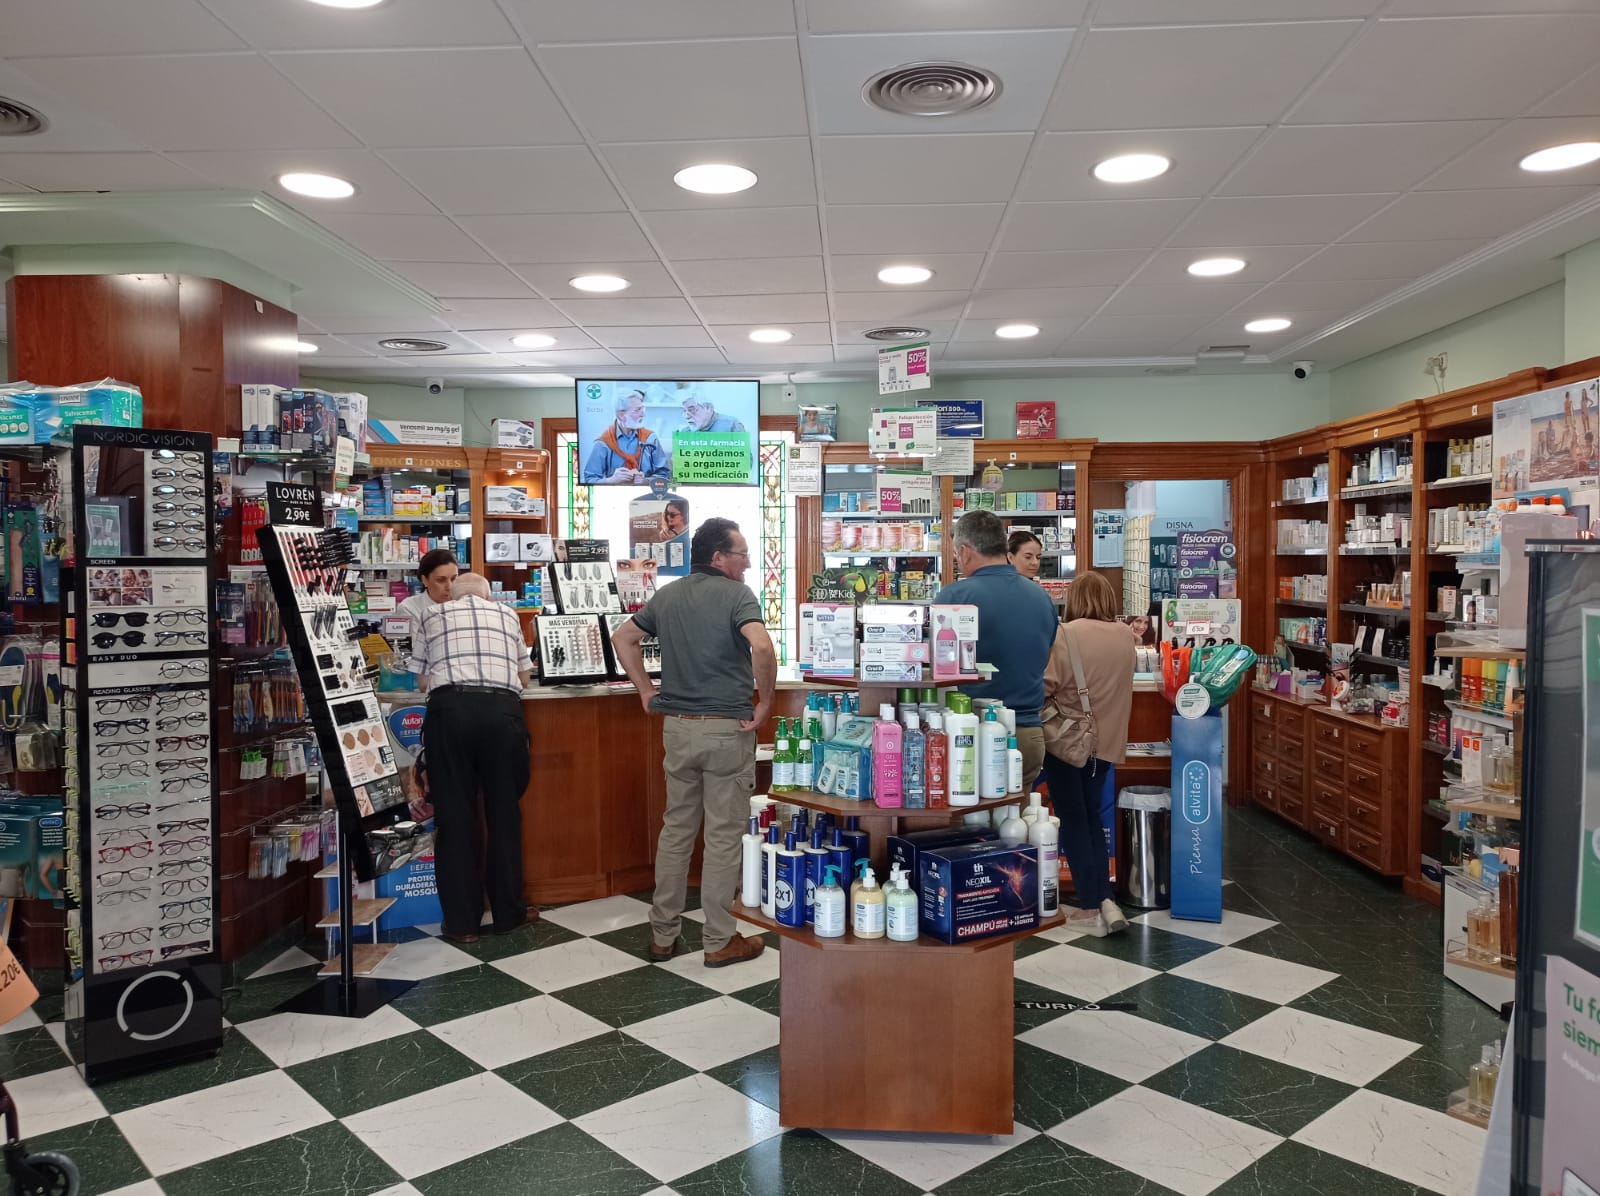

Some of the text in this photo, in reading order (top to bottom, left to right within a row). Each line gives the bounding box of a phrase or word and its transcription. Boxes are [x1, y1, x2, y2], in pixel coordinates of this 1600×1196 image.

[93, 431, 196, 447] NORDIC VISION
[709, 439, 746, 447] farmacia
[679, 449, 745, 460] Le ayudamos
[692, 461, 741, 470] organizar
[693, 471, 749, 479] medicación
[275, 486, 316, 501] LOVRÉN
[881, 490, 901, 501] 50%
[285, 507, 311, 522] 2,99€
[1166, 521, 1194, 529] DISNA
[1182, 533, 1229, 544] fisiocrem
[1180, 548, 1209, 556] fisiocrem
[838, 589, 856, 599] Kids
[120, 653, 138, 661] DUO
[1192, 781, 1201, 816] alvita
[1190, 827, 1203, 875] Piensa
[973, 863, 984, 873] th
[965, 876, 992, 887] NEOXIL
[776, 886, 791, 902] 2x1
[957, 920, 996, 936] CHAMPÚ
[1563, 983, 1584, 1012] Tu
